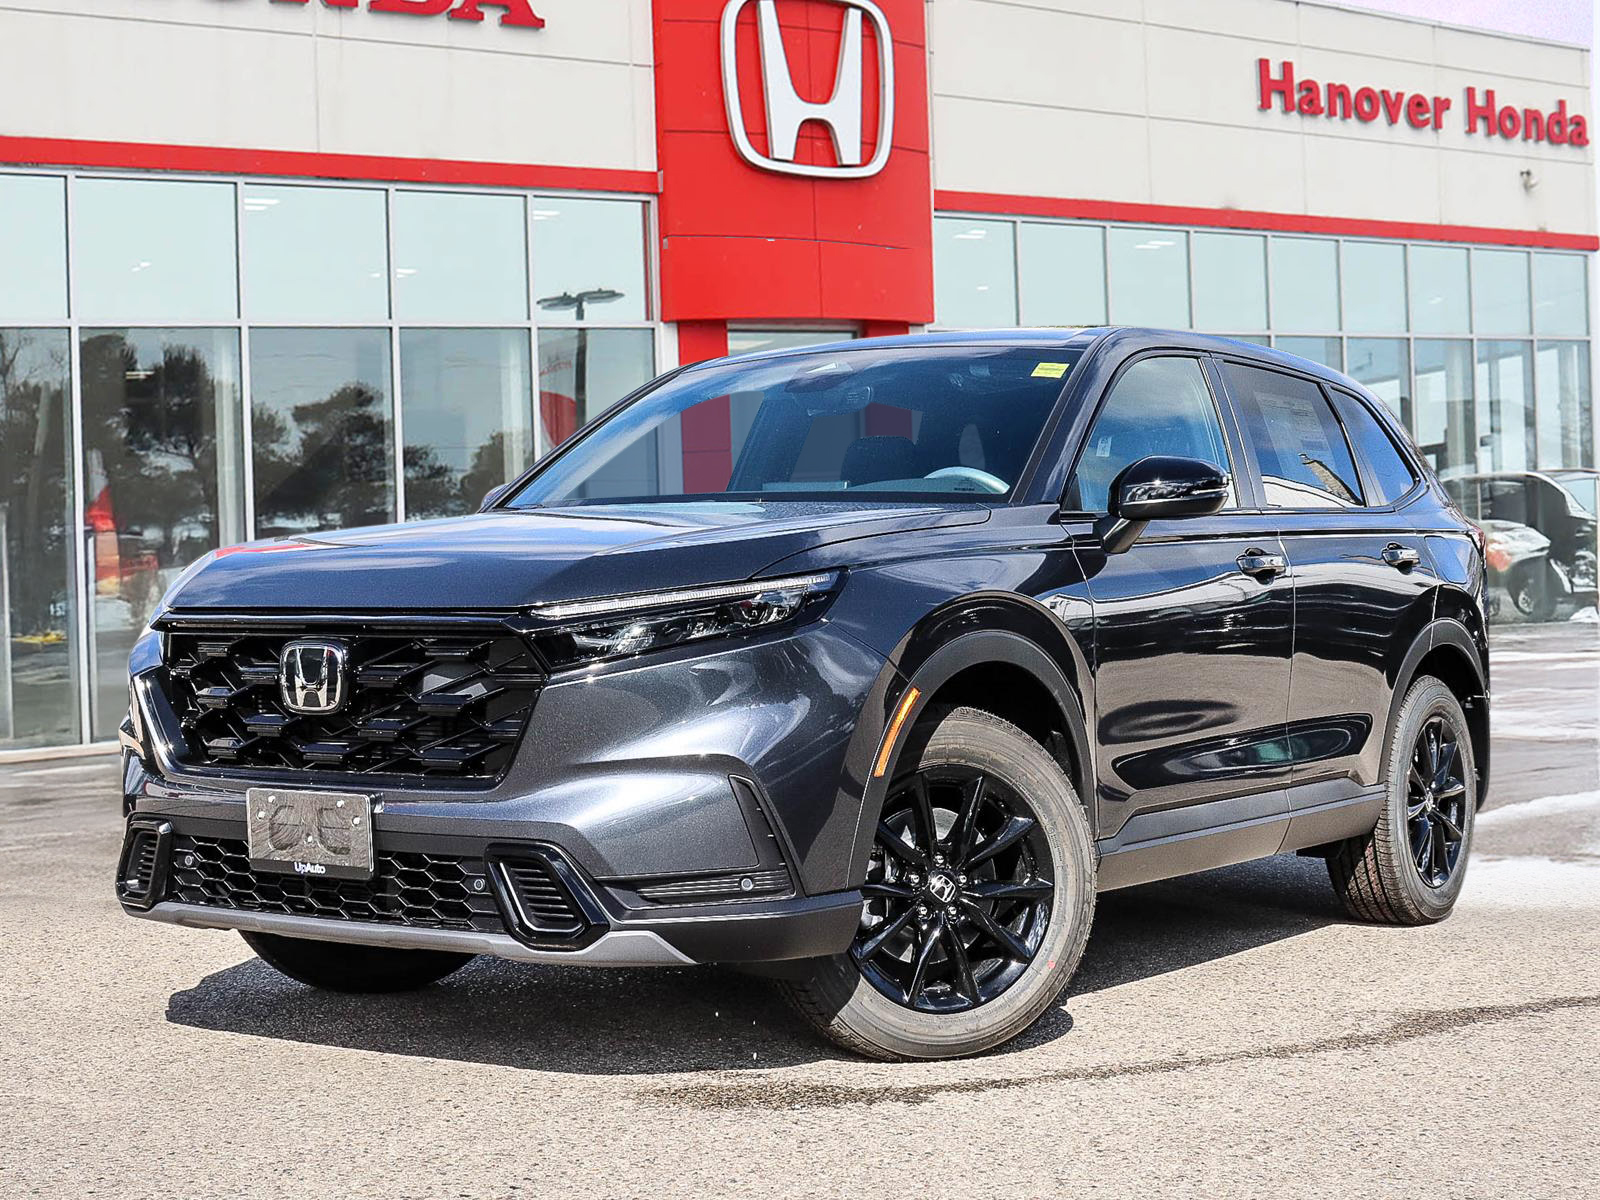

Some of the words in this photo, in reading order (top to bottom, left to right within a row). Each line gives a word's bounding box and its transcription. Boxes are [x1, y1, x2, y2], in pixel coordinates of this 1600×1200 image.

[1259, 58, 1451, 129] Hanover
[1467, 87, 1589, 146] Honda
[294, 861, 326, 875] UpAuto
